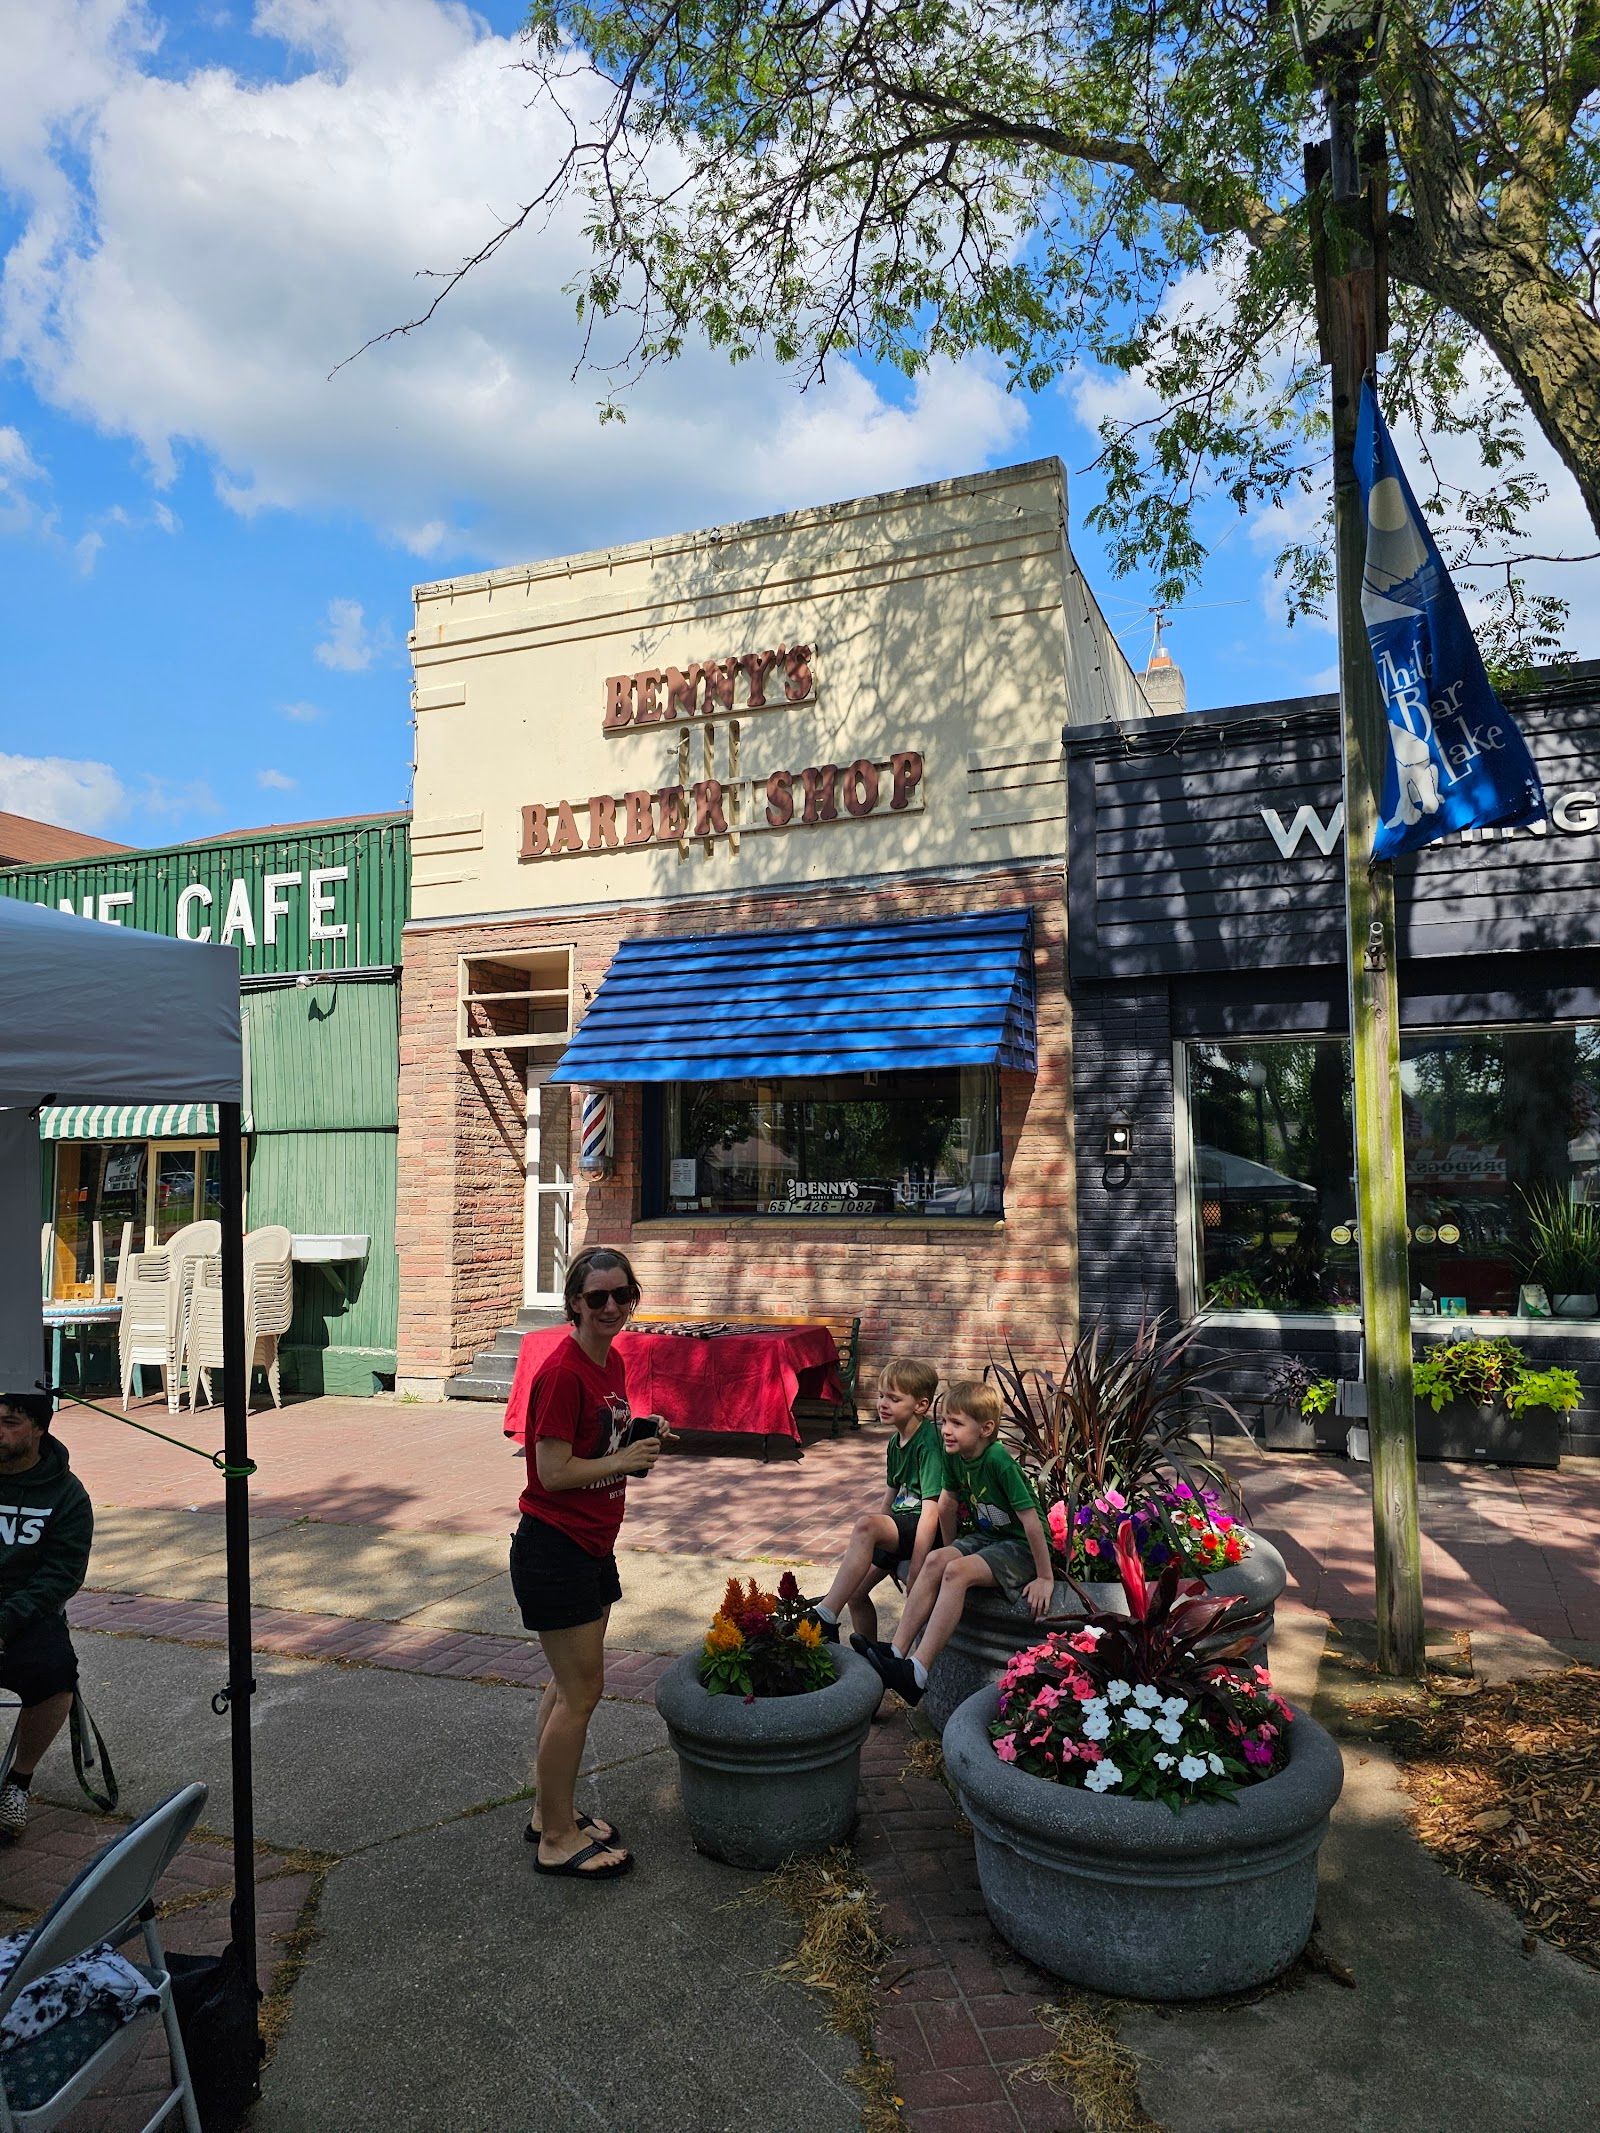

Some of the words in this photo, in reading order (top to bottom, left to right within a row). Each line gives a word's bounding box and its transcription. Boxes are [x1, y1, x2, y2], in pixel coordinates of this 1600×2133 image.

[602, 643, 813, 729] BENNY'S
[1433, 715, 1506, 787] Lake
[520, 779, 729, 857] BARBER
[765, 751, 924, 826] SHOP
[176, 866, 348, 947] CAFE
[770, 1201, 874, 1213] 651-426-1082
[795, 1180, 859, 1198] BENNY'S
[900, 1183, 935, 1200] OPEN
[0, 1515, 45, 1545] NS
